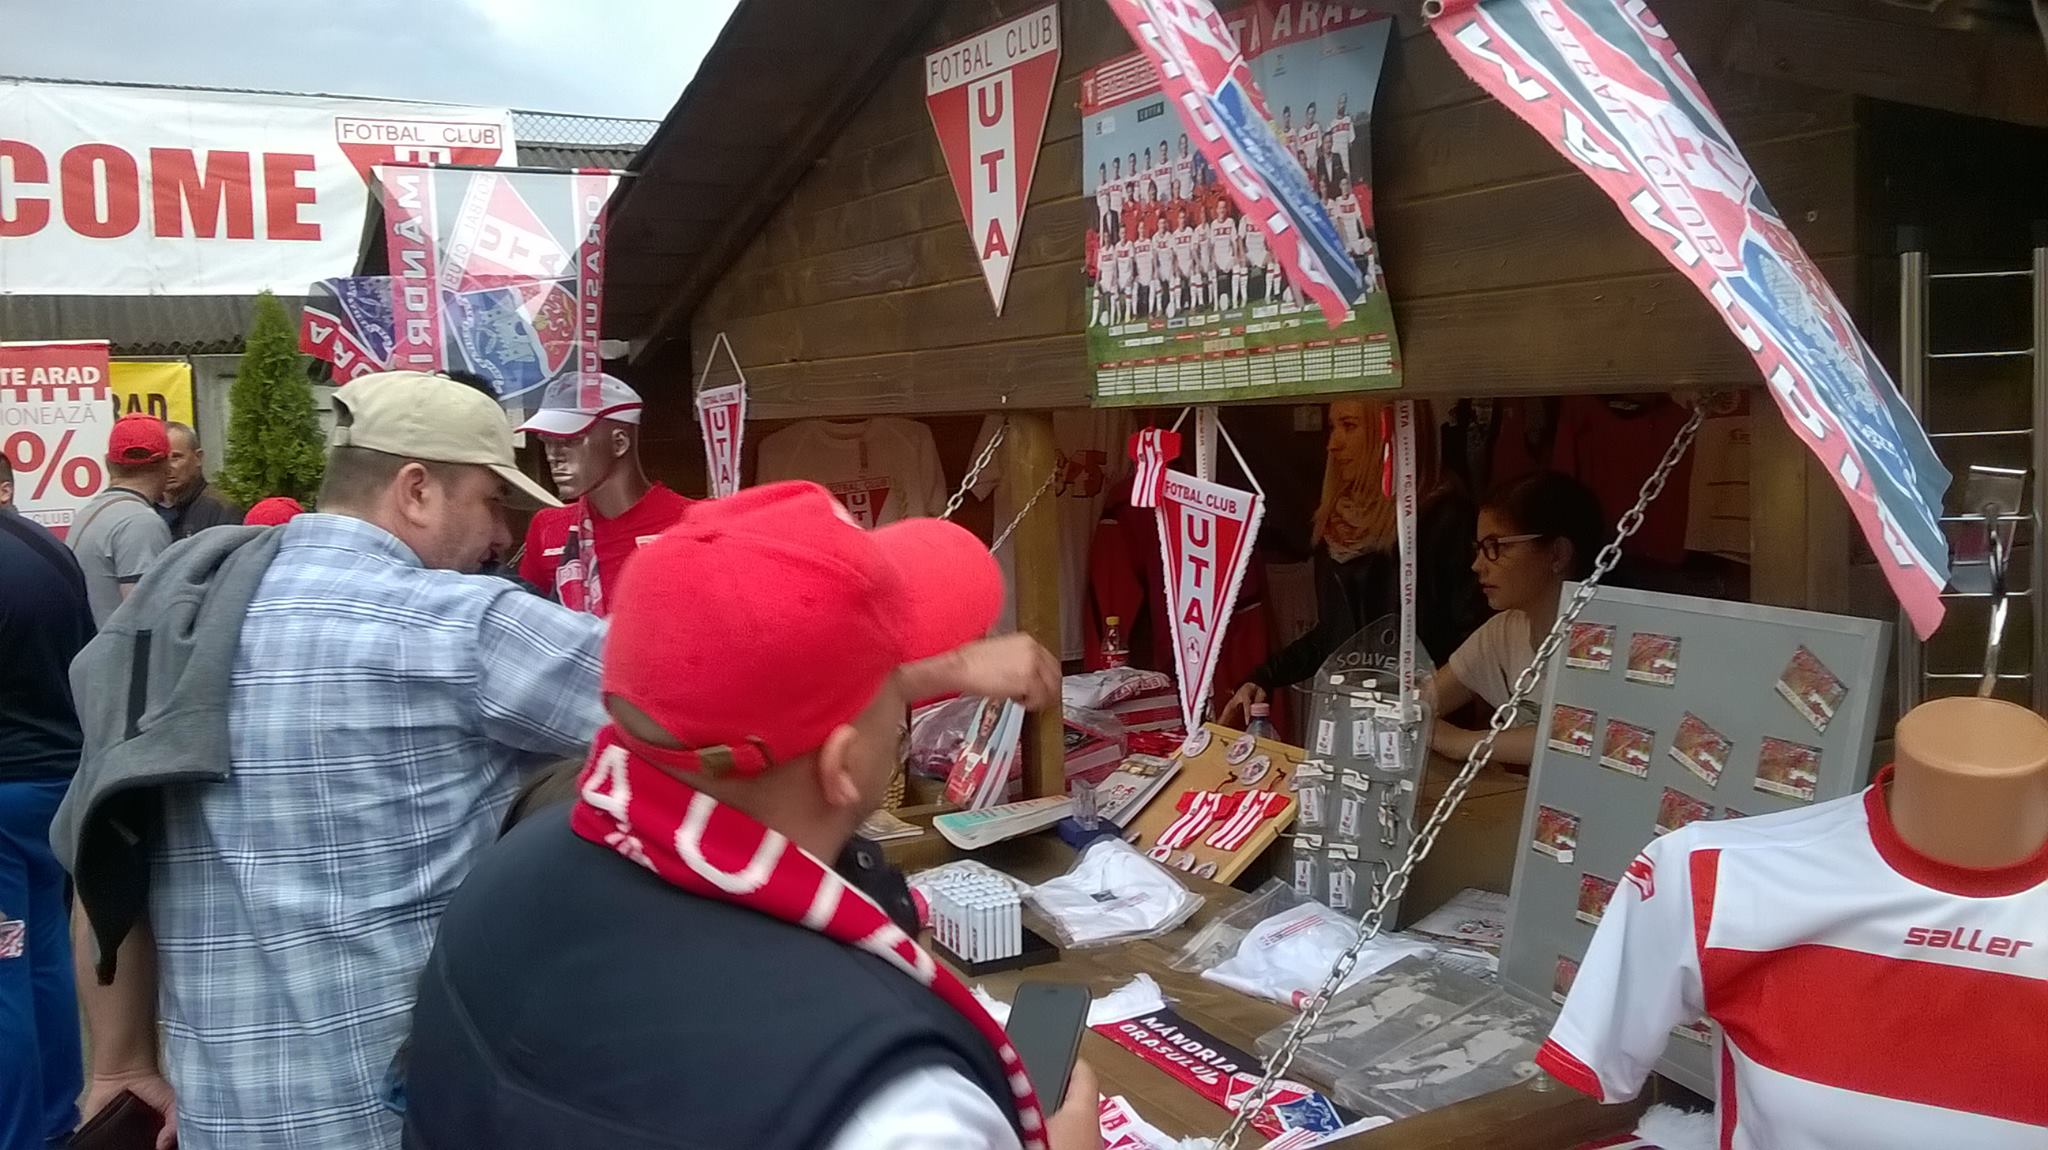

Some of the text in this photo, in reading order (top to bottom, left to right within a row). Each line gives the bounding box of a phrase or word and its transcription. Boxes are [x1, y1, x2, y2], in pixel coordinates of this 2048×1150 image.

[930, 15, 1052, 87] FOTBAL CLUB
[342, 122, 496, 144] FOTBAL CLUB
[978, 80, 1009, 261] UTA
[0, 139, 321, 242] COME
[31, 366, 100, 385] ARAD
[712, 411, 731, 484] UTA
[851, 493, 868, 521] UT
[1165, 480, 1237, 515] FOTBAL CLUB
[32, 512, 71, 526] CLUB
[1183, 513, 1210, 633] UTA
[1336, 651, 1400, 671] SOUVE
[1903, 926, 2033, 959] saller
